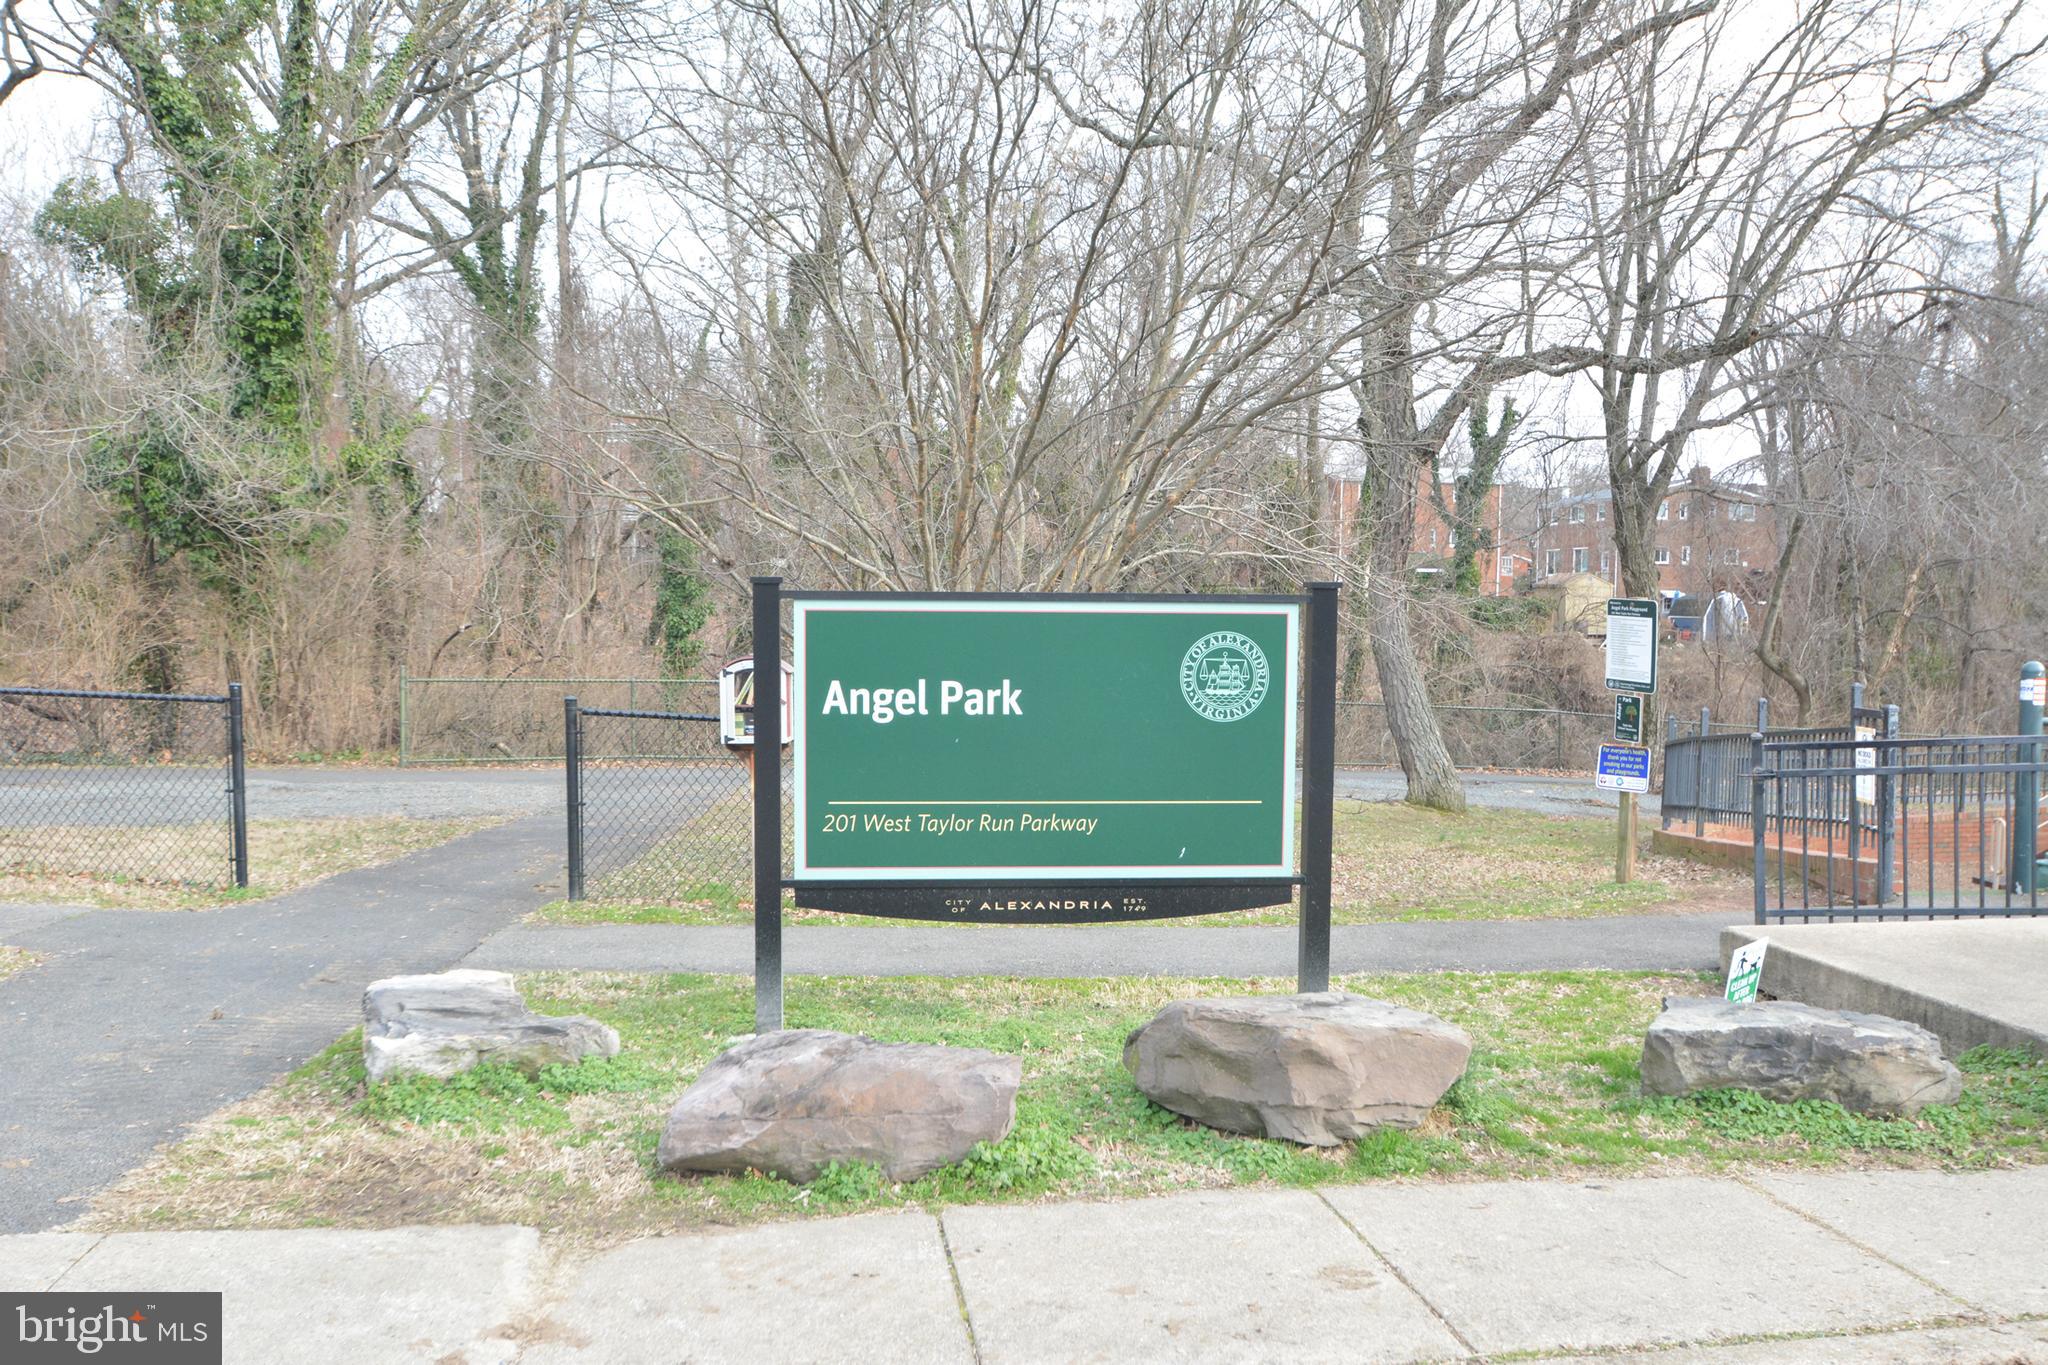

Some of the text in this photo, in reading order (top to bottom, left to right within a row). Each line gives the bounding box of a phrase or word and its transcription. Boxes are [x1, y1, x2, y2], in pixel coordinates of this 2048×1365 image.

[1184, 633, 1267, 692] CITY OF ALEXANDRIA
[822, 678, 1024, 724] Angel Park
[1191, 694, 1260, 720] VIRGINIA
[822, 814, 1098, 836] 201 West Taylor Run Parkway
[979, 900, 1113, 911] ALEXANDRIA
